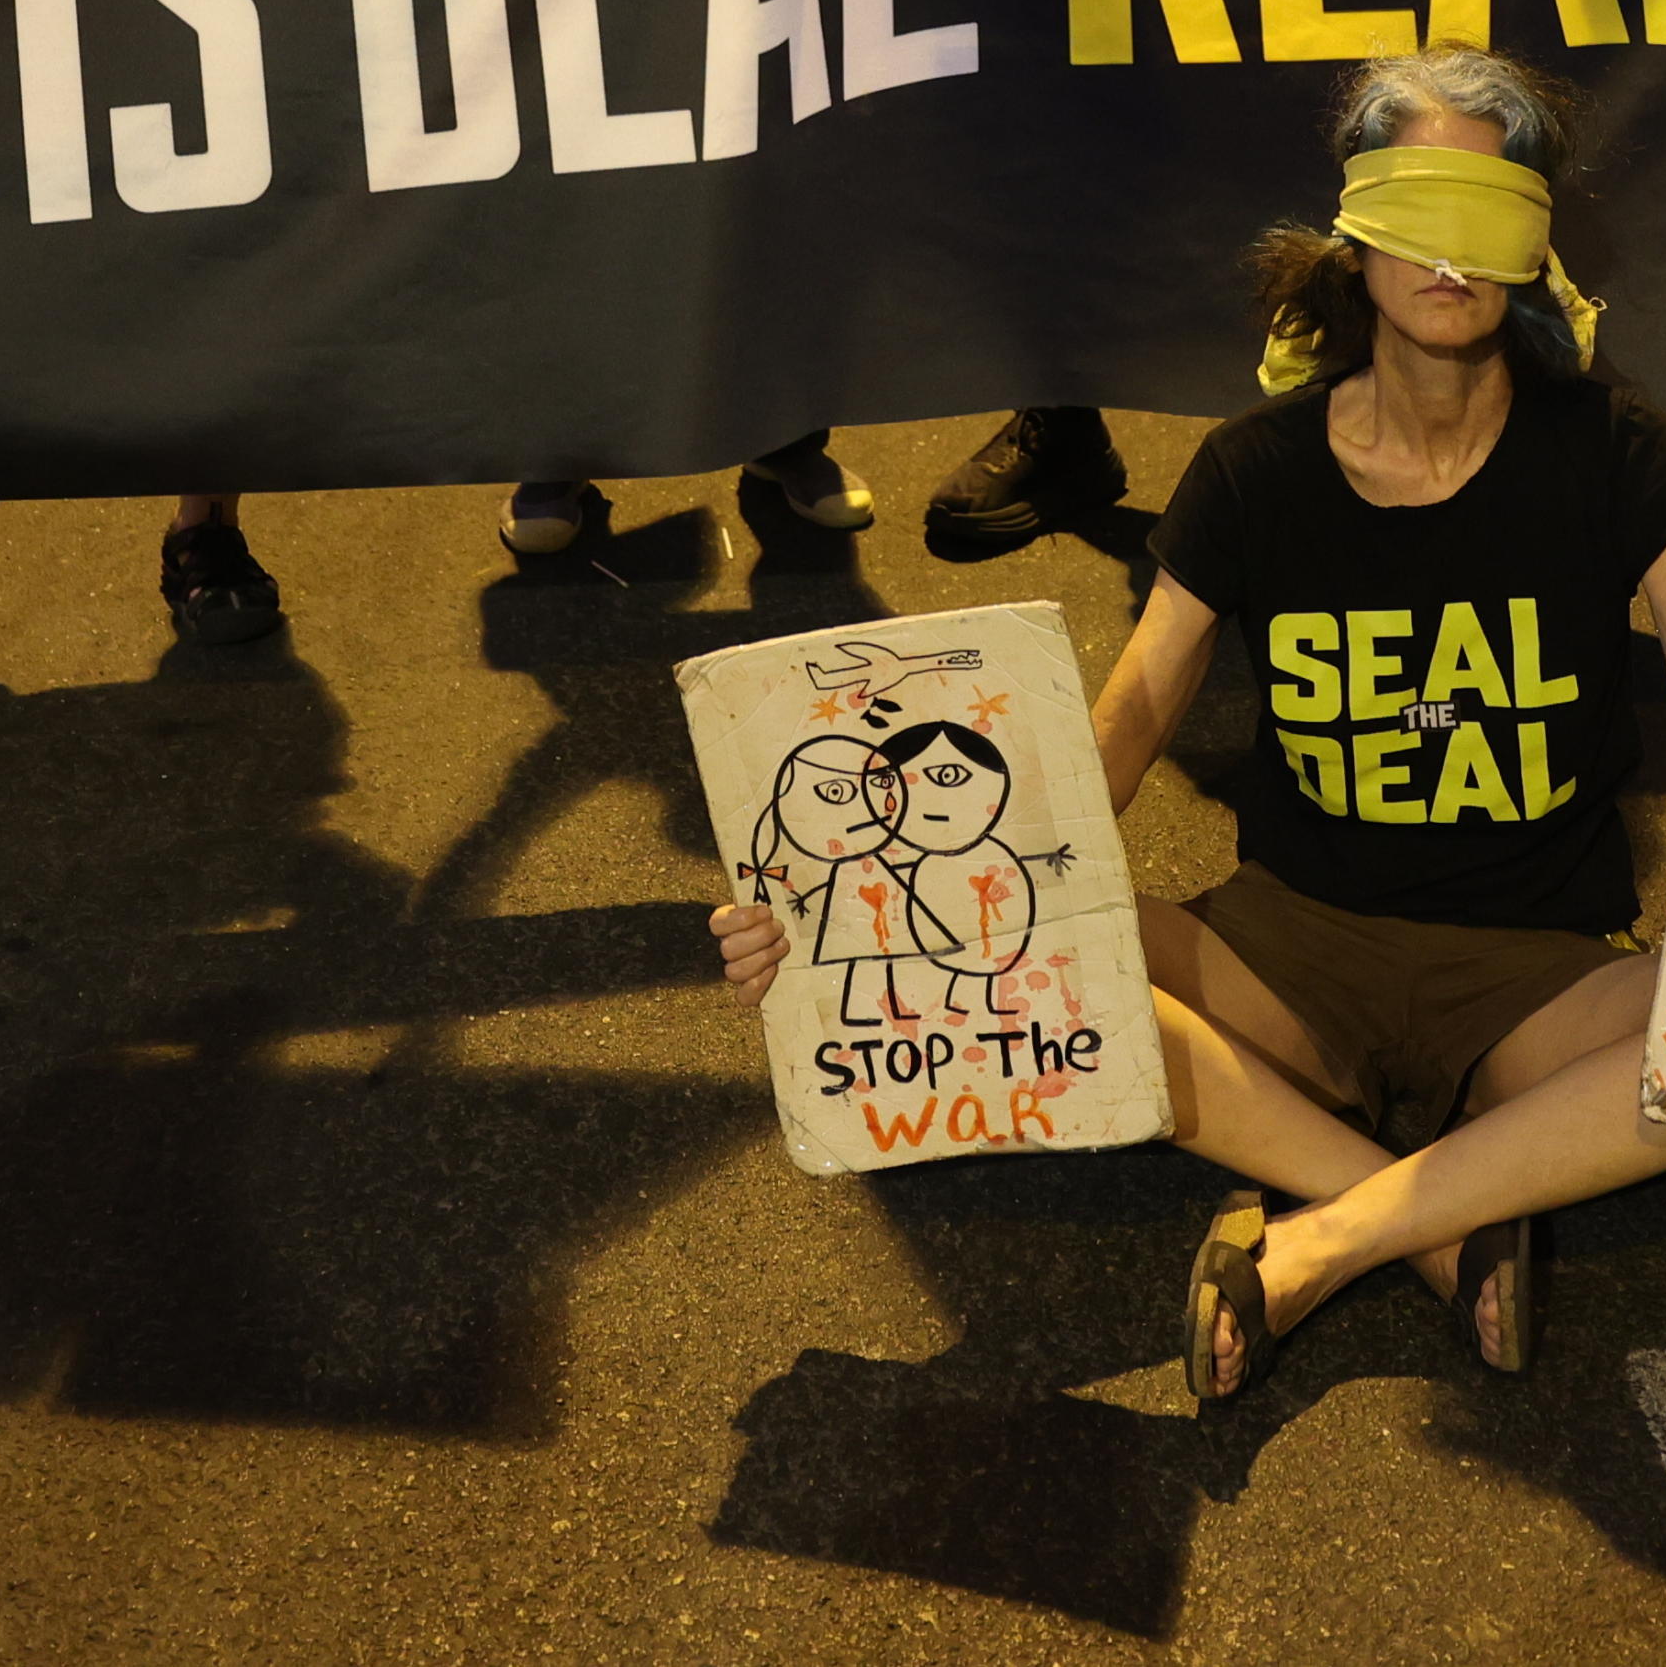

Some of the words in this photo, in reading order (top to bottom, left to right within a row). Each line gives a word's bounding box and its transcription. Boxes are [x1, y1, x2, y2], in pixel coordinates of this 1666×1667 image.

[1269, 597, 1579, 723] SEAL
[1404, 702, 1457, 730] THE
[1275, 720, 1577, 824] DEAL
[814, 1032, 953, 1096] STOP
